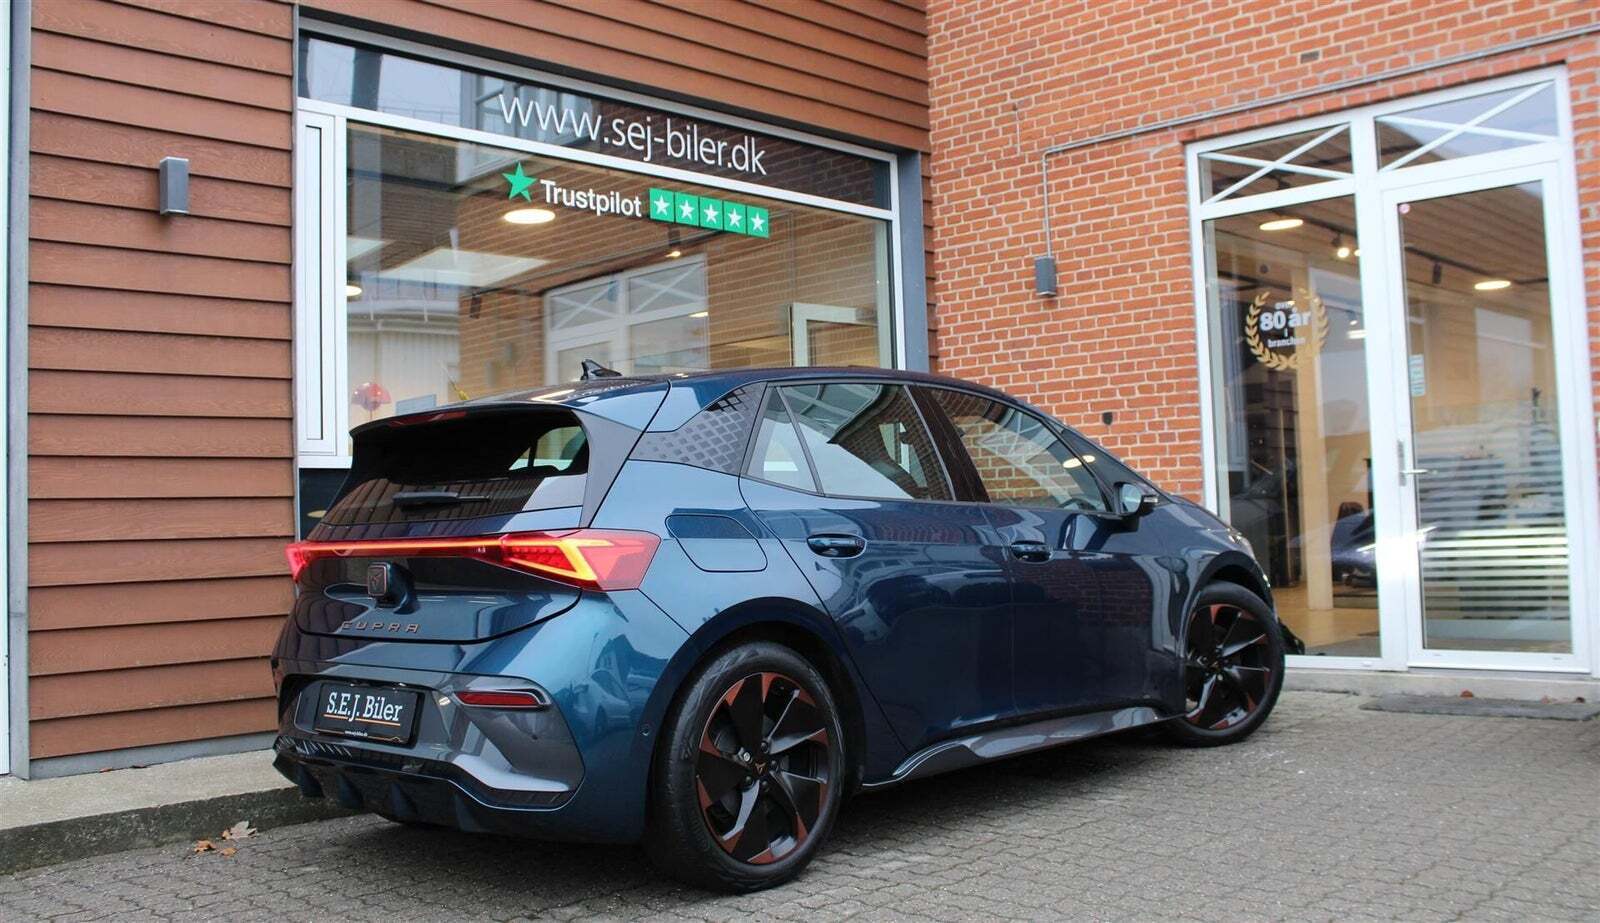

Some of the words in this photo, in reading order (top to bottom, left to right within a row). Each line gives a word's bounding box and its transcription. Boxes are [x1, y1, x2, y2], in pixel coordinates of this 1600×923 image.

[499, 93, 767, 176] www.sej-biler.dk
[540, 178, 643, 218] Trustpilot
[1260, 311, 1287, 331] 80
[1288, 306, 1311, 328] år
[340, 620, 420, 634] CUPRA
[326, 691, 361, 722] S.E.J.
[362, 695, 403, 721] Biler
